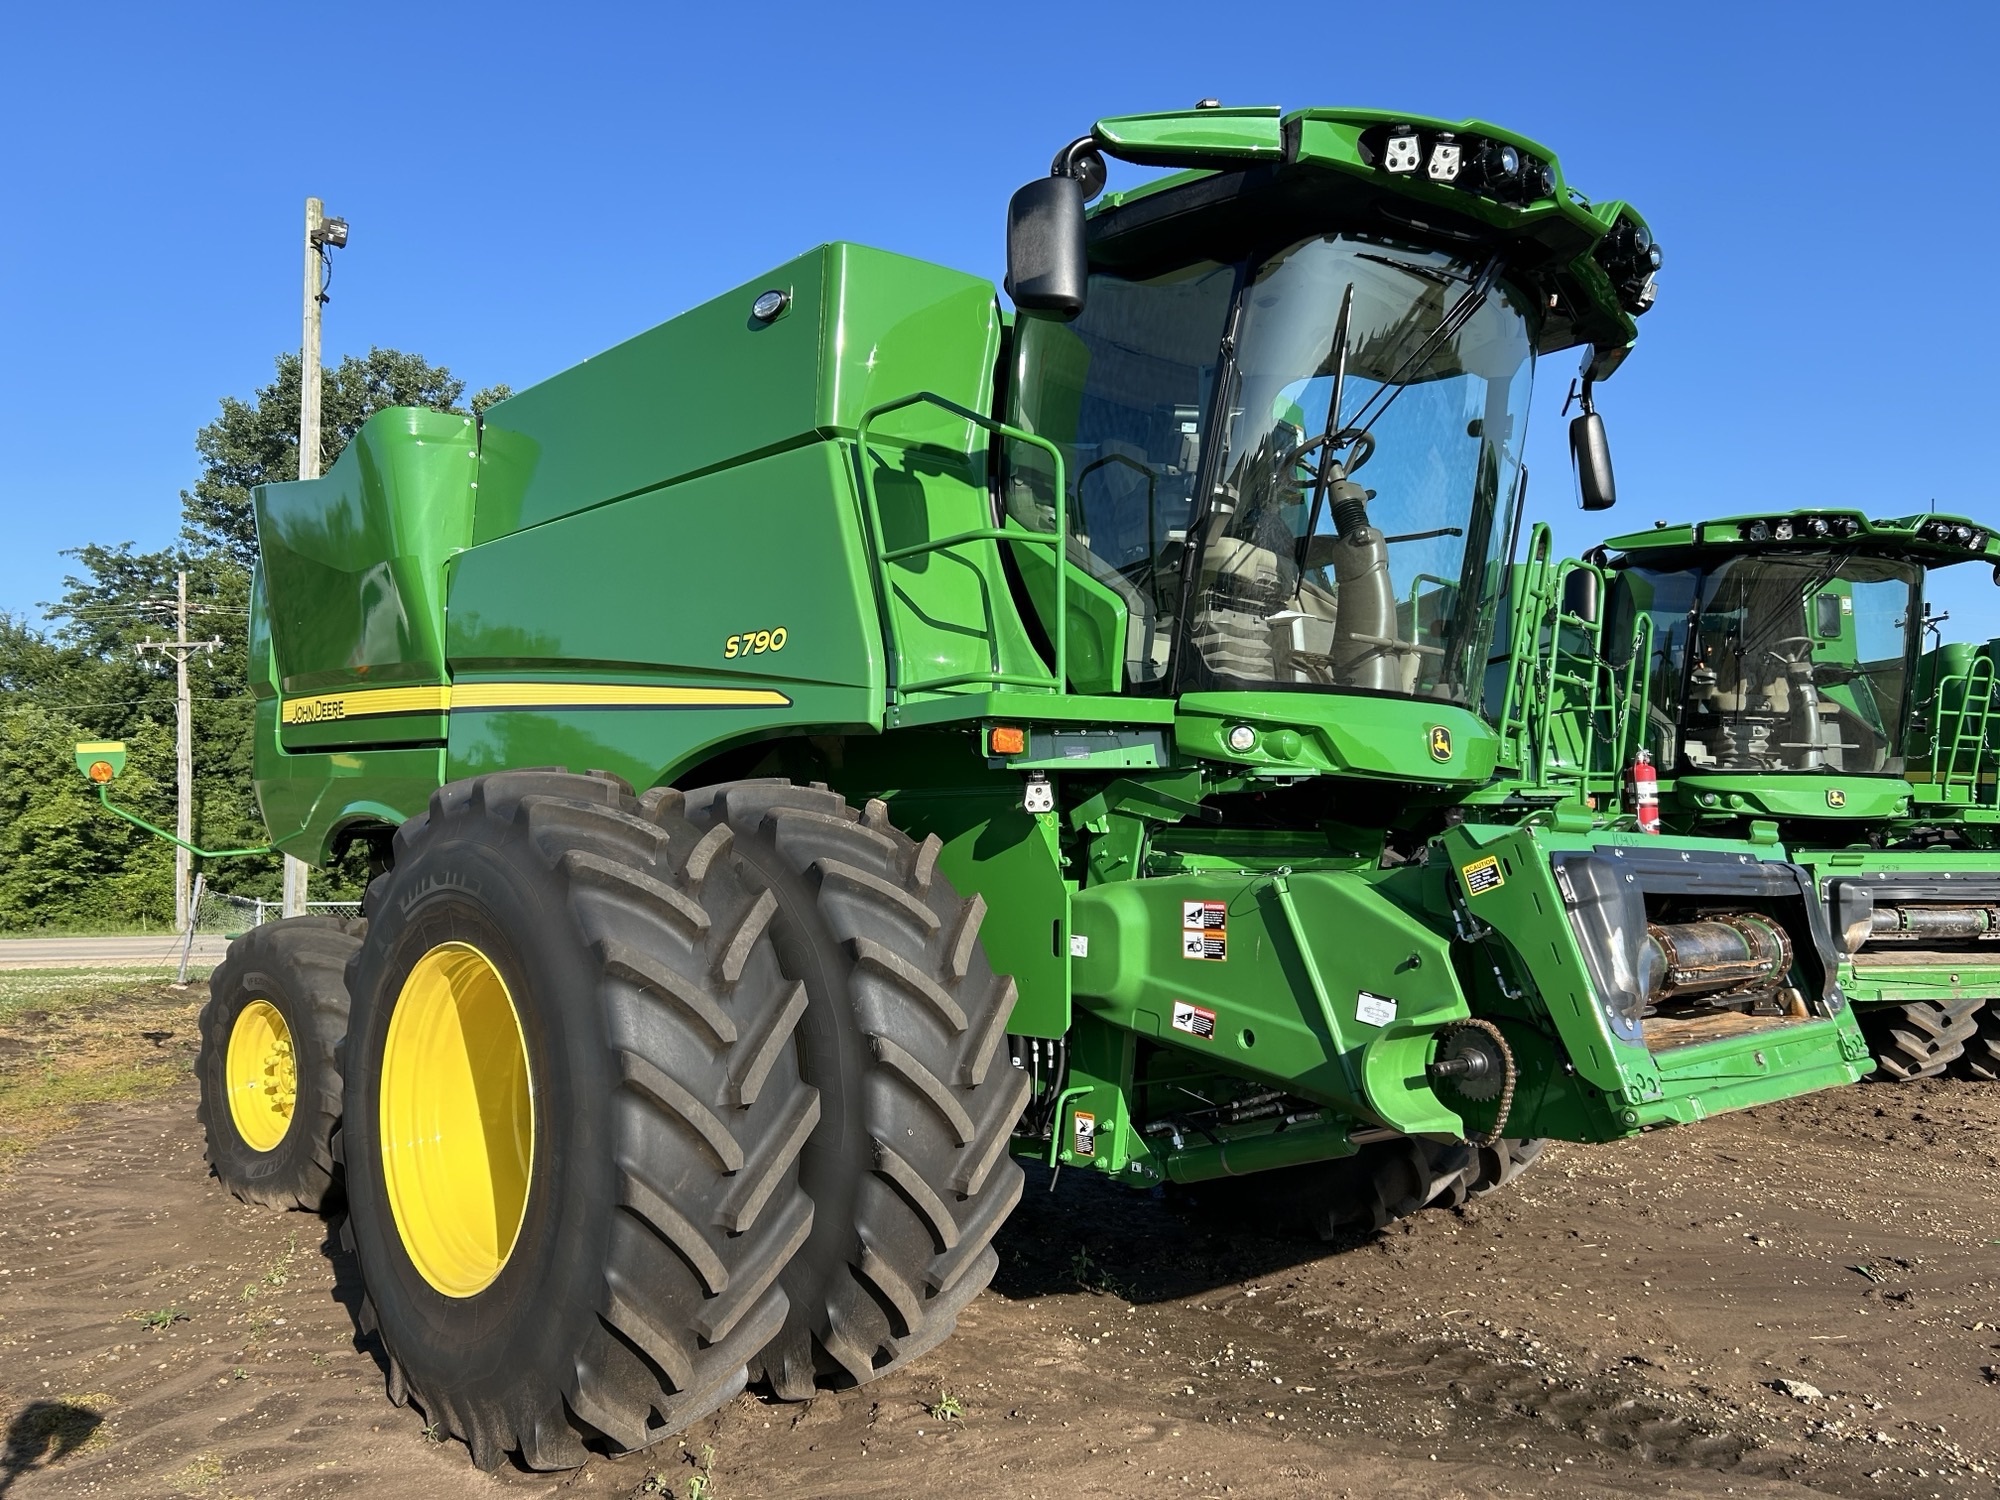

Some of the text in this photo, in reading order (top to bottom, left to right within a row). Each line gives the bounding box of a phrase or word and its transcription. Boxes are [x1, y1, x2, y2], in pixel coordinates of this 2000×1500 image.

[724, 626, 788, 660] S790
[292, 700, 345, 724] JOHN DEERE
[1468, 858, 1495, 872] CAUTION
